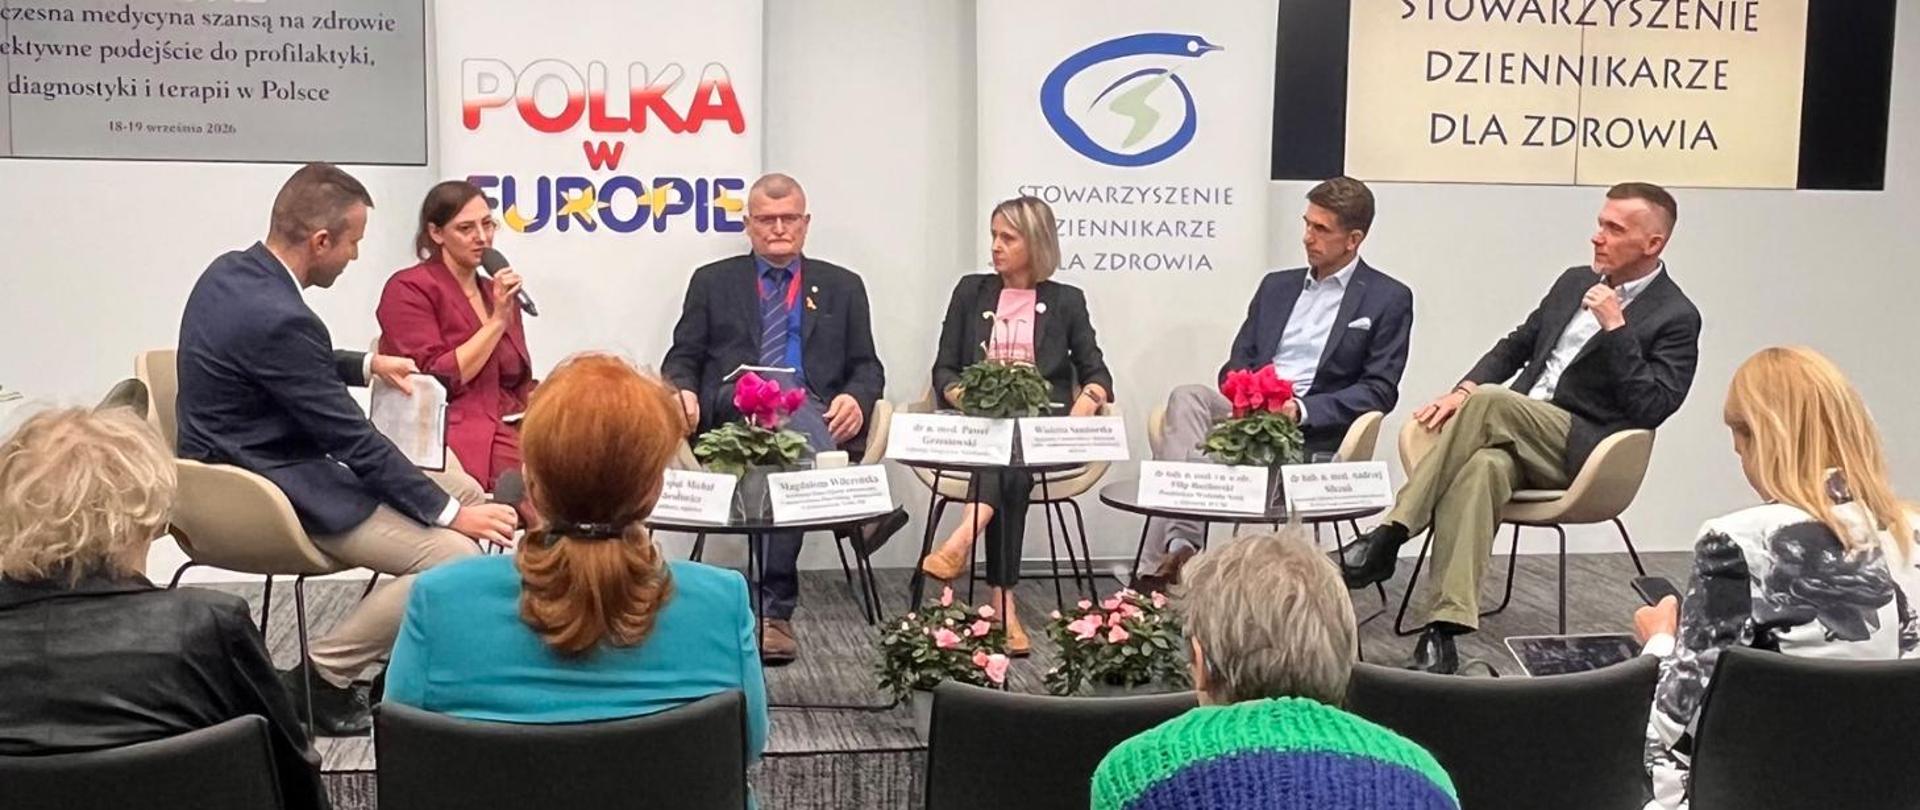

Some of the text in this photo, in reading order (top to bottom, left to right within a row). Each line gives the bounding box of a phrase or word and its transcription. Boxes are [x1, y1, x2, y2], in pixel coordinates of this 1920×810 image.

[82, 5, 195, 30] medycyna
[201, 11, 273, 34] szansą
[279, 15, 305, 30] na
[312, 11, 396, 33] zdrowie
[99, 38, 202, 65] podejście
[210, 41, 238, 62] do
[245, 43, 376, 69] profilaktyki,
[1426, 51, 1730, 91] DZIENNIKARZE
[8, 75, 330, 104] diagnostyki i terapii w Polsce
[461, 57, 745, 133] POLKA
[108, 120, 143, 133] 18-19
[1430, 113, 1718, 151] DLA ZDROWIA
[1018, 185, 1233, 205] STOWARZYSZENIE
[1055, 219, 1216, 238] ZIENNIKARZE
[1056, 253, 1213, 271] LA ZDROWIA
